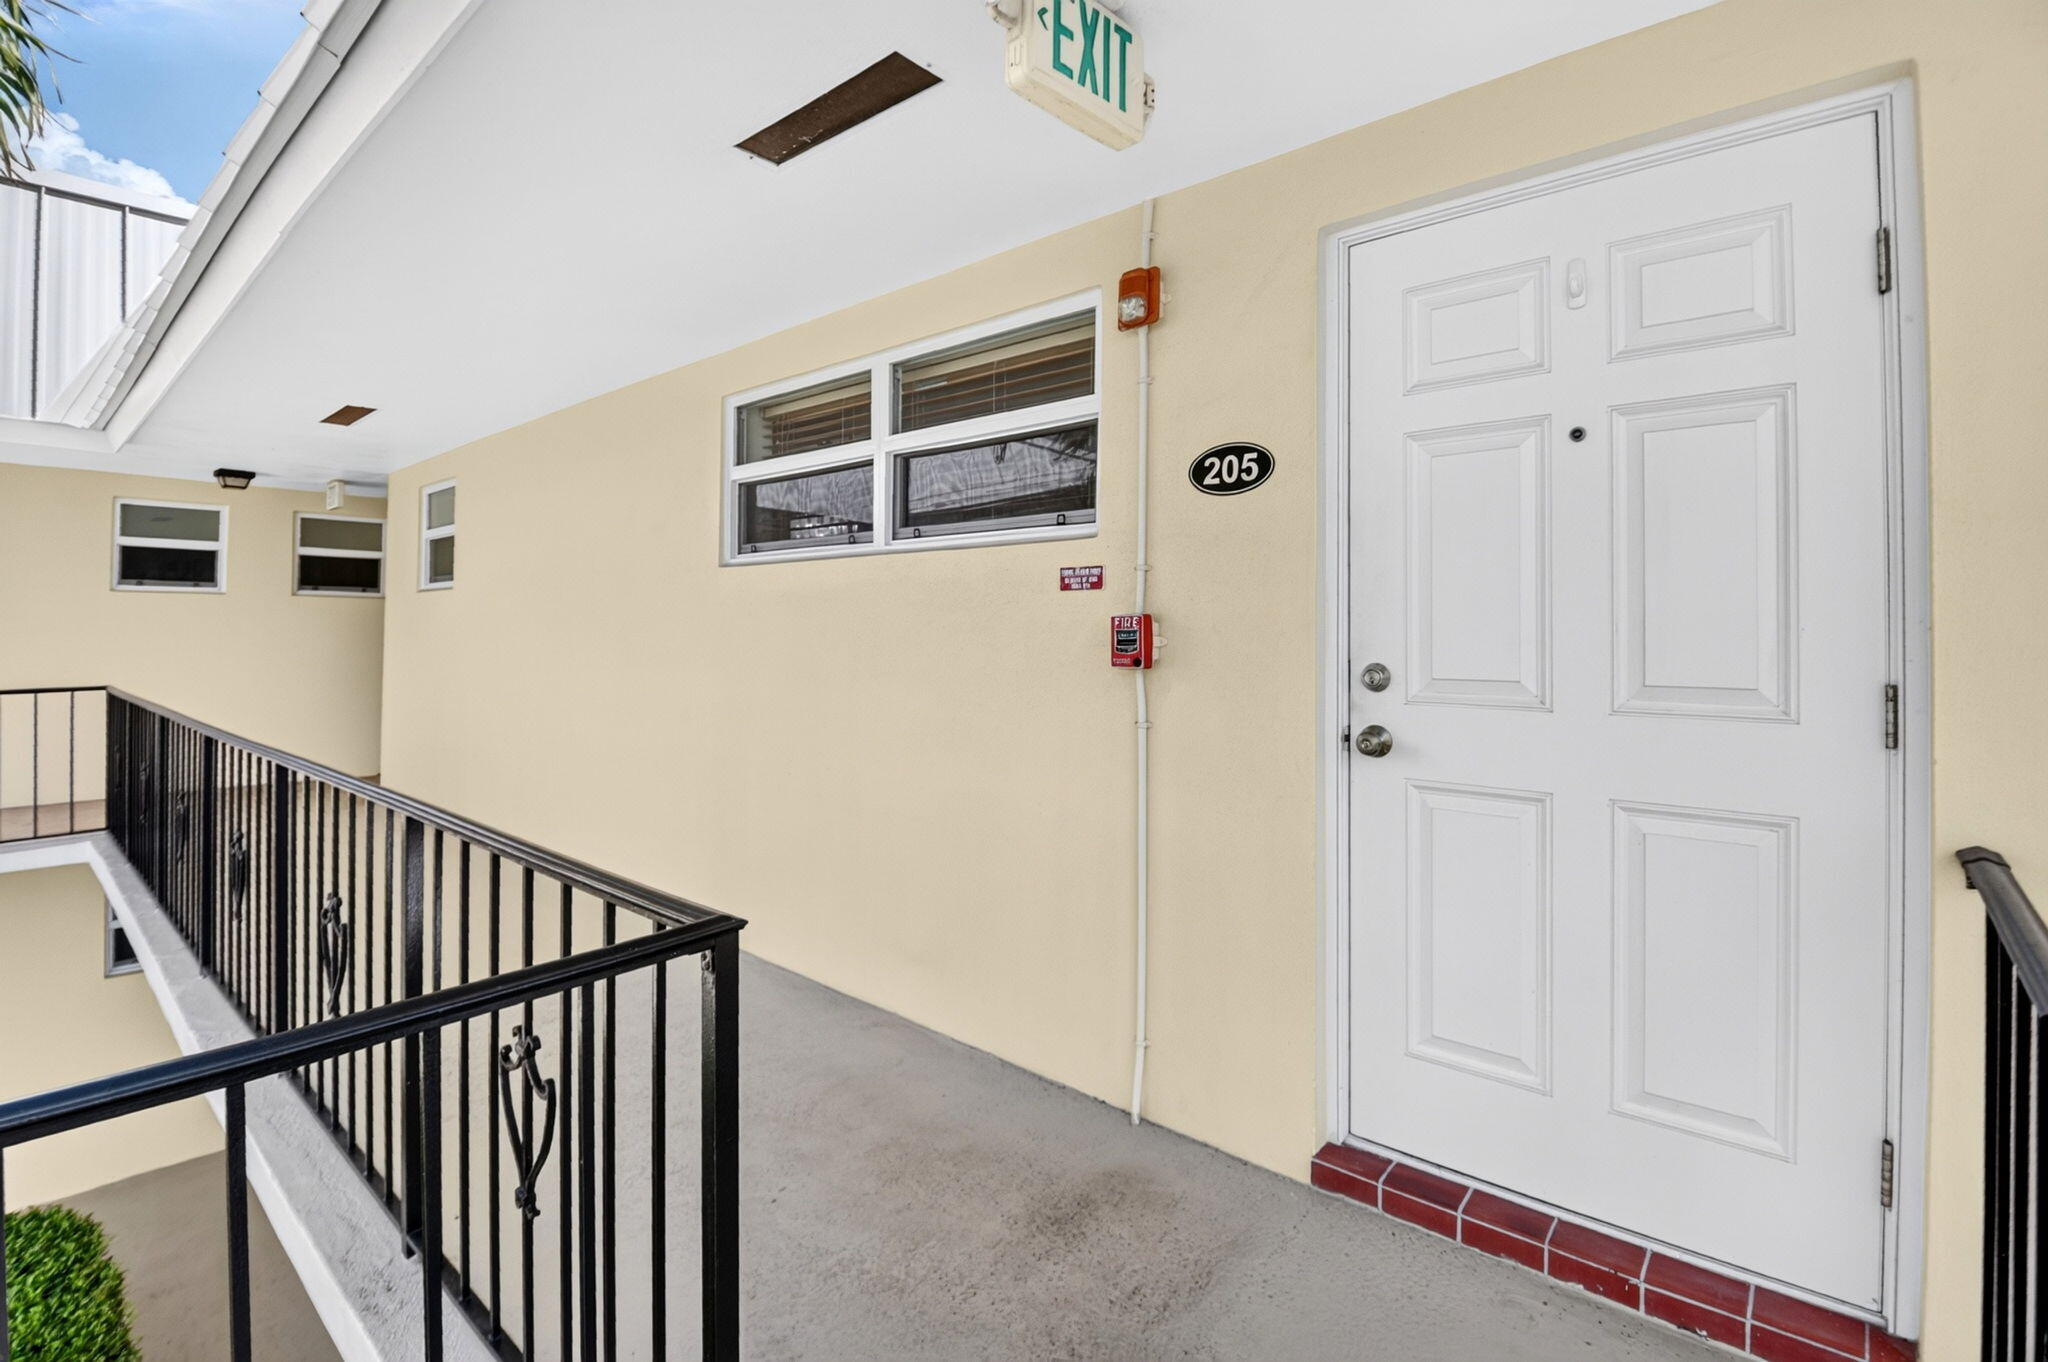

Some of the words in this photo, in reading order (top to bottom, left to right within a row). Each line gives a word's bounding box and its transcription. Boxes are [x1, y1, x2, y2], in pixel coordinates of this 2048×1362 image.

[1052, 0, 1133, 112] EXIT
[1203, 452, 1258, 485] 205
[1114, 616, 1140, 629] FIRE
